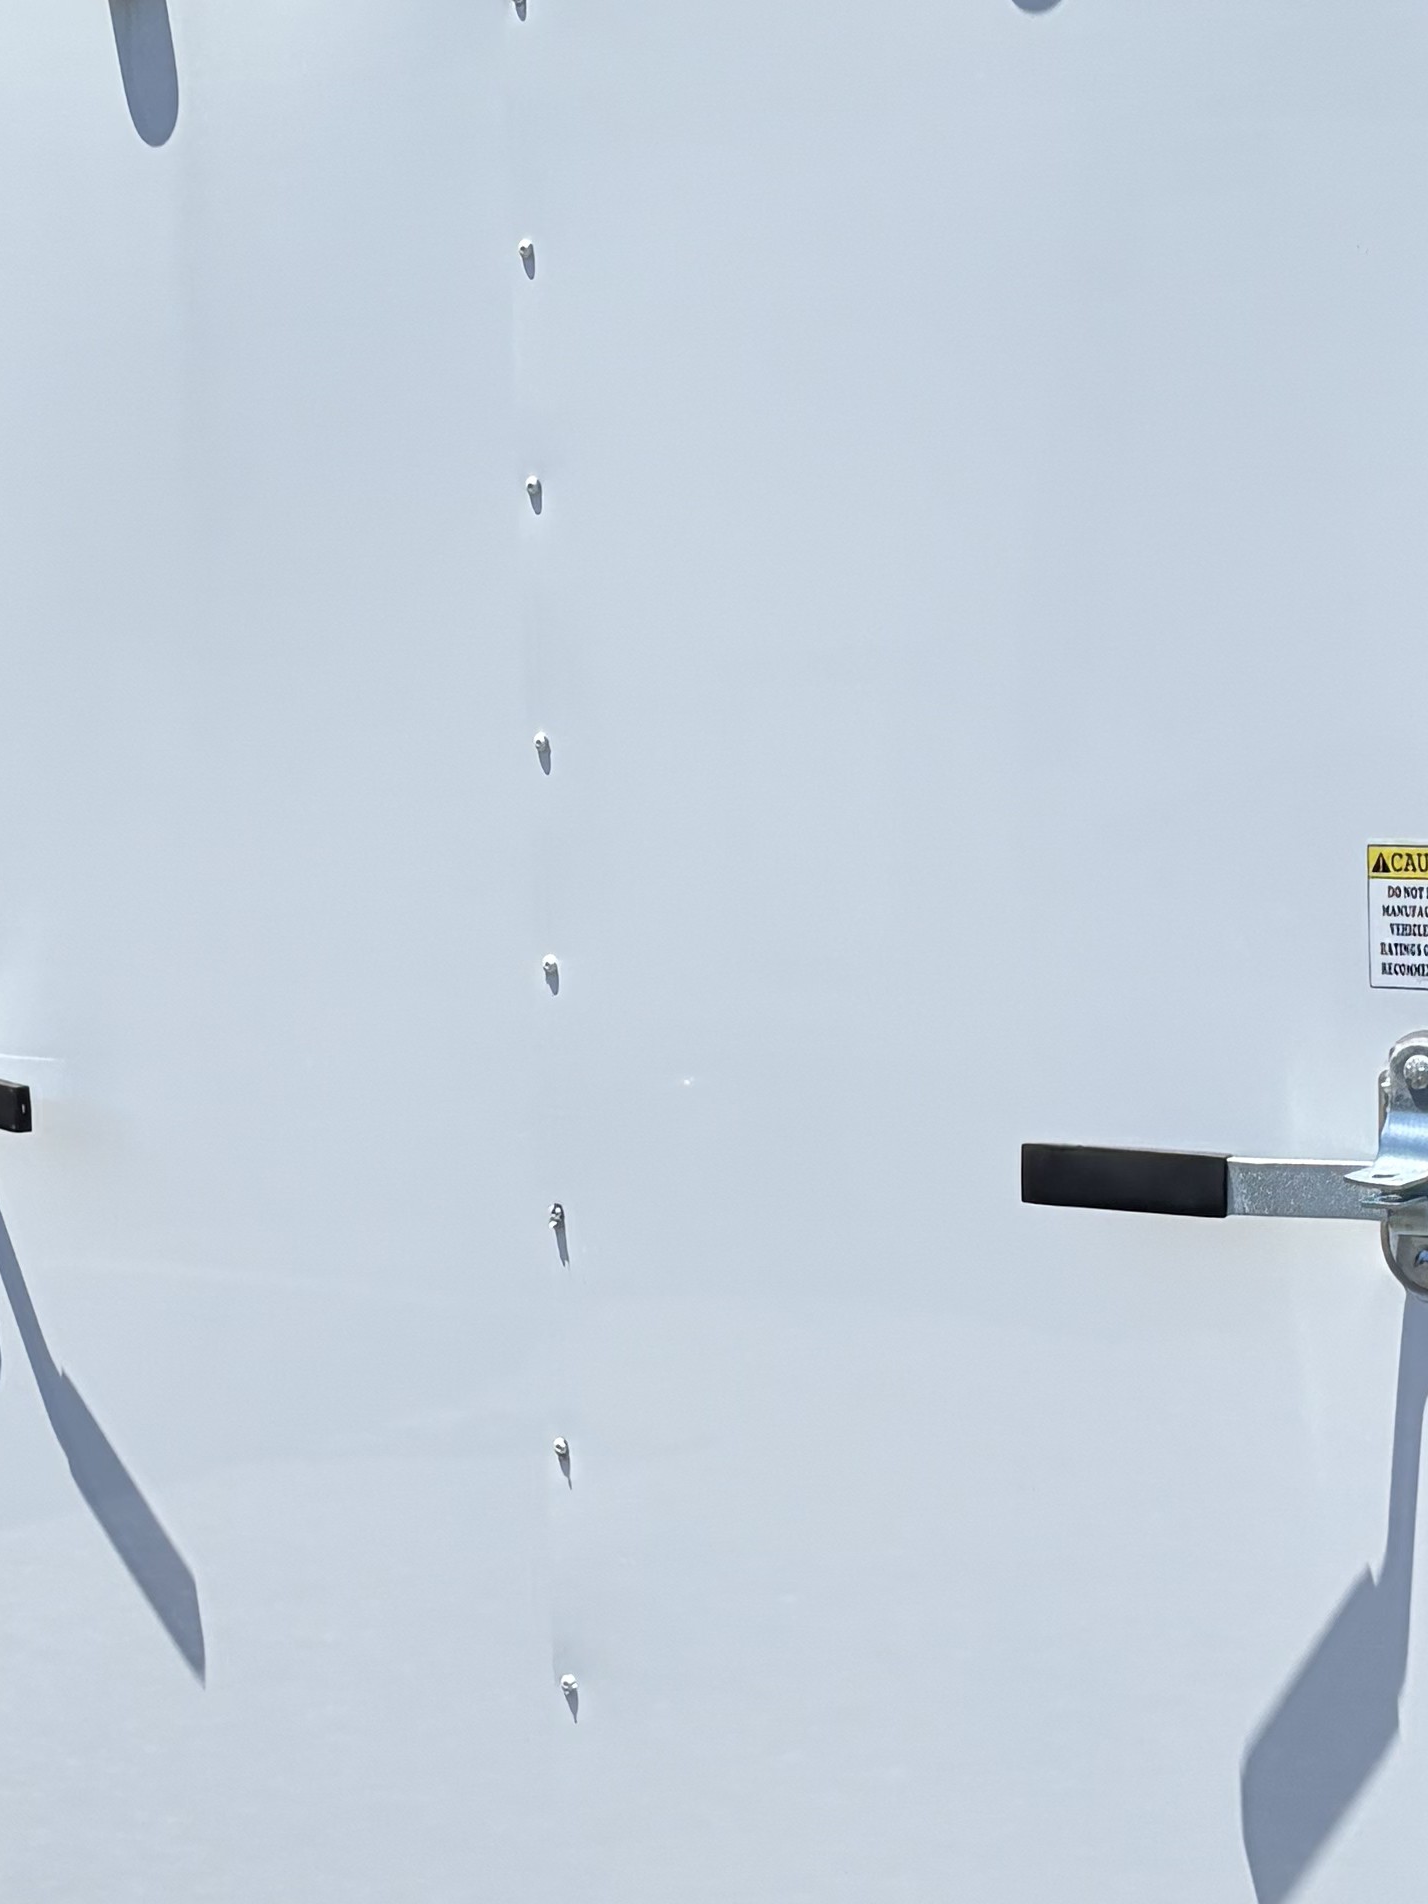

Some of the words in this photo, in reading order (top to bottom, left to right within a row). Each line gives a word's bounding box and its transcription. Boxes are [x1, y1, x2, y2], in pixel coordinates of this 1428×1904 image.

[1388, 885, 1401, 899] DO
[1404, 886, 1424, 900] NOT
[1389, 923, 1428, 937] VEHICLE
[1380, 942, 1422, 956] RATINGS
